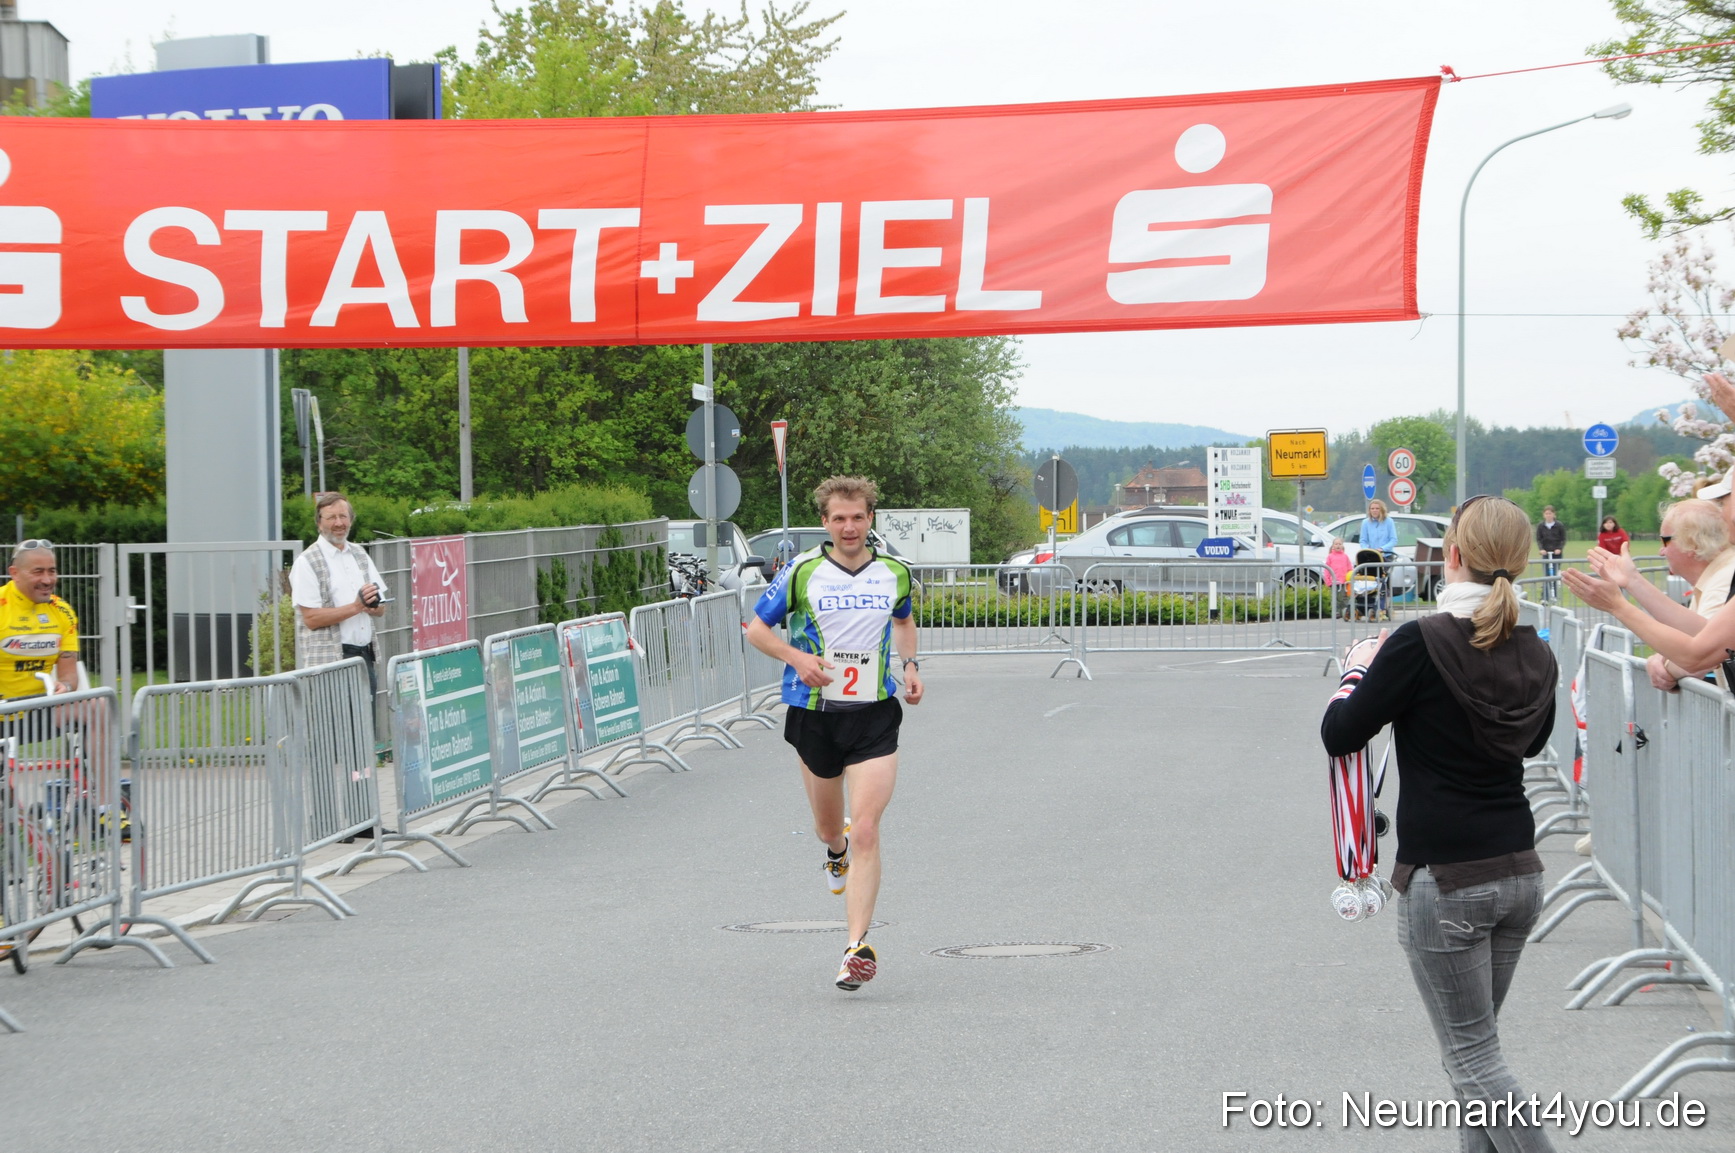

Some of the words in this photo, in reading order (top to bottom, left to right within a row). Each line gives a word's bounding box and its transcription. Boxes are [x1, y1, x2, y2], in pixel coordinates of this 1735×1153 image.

[1275, 447, 1321, 460] Neumarkt
[1395, 456, 1409, 469] 60
[1220, 509, 1237, 520] THULE
[1203, 545, 1230, 556] VOLVO
[820, 583, 853, 591] TEAM
[420, 589, 462, 627] ZEITLOS
[818, 594, 890, 611] BOCK
[3, 638, 56, 650] Mercatone
[834, 651, 859, 659] MEYER
[590, 669, 598, 686] Fun
[601, 665, 613, 684] Action
[842, 666, 859, 696] 2
[528, 683, 541, 702] Action
[429, 712, 439, 732] Fun
[439, 710, 444, 729] &
[444, 706, 460, 728] Action
[459, 703, 466, 722] in
[431, 737, 451, 762] sicheren
[451, 731, 473, 757] Bahnen!
